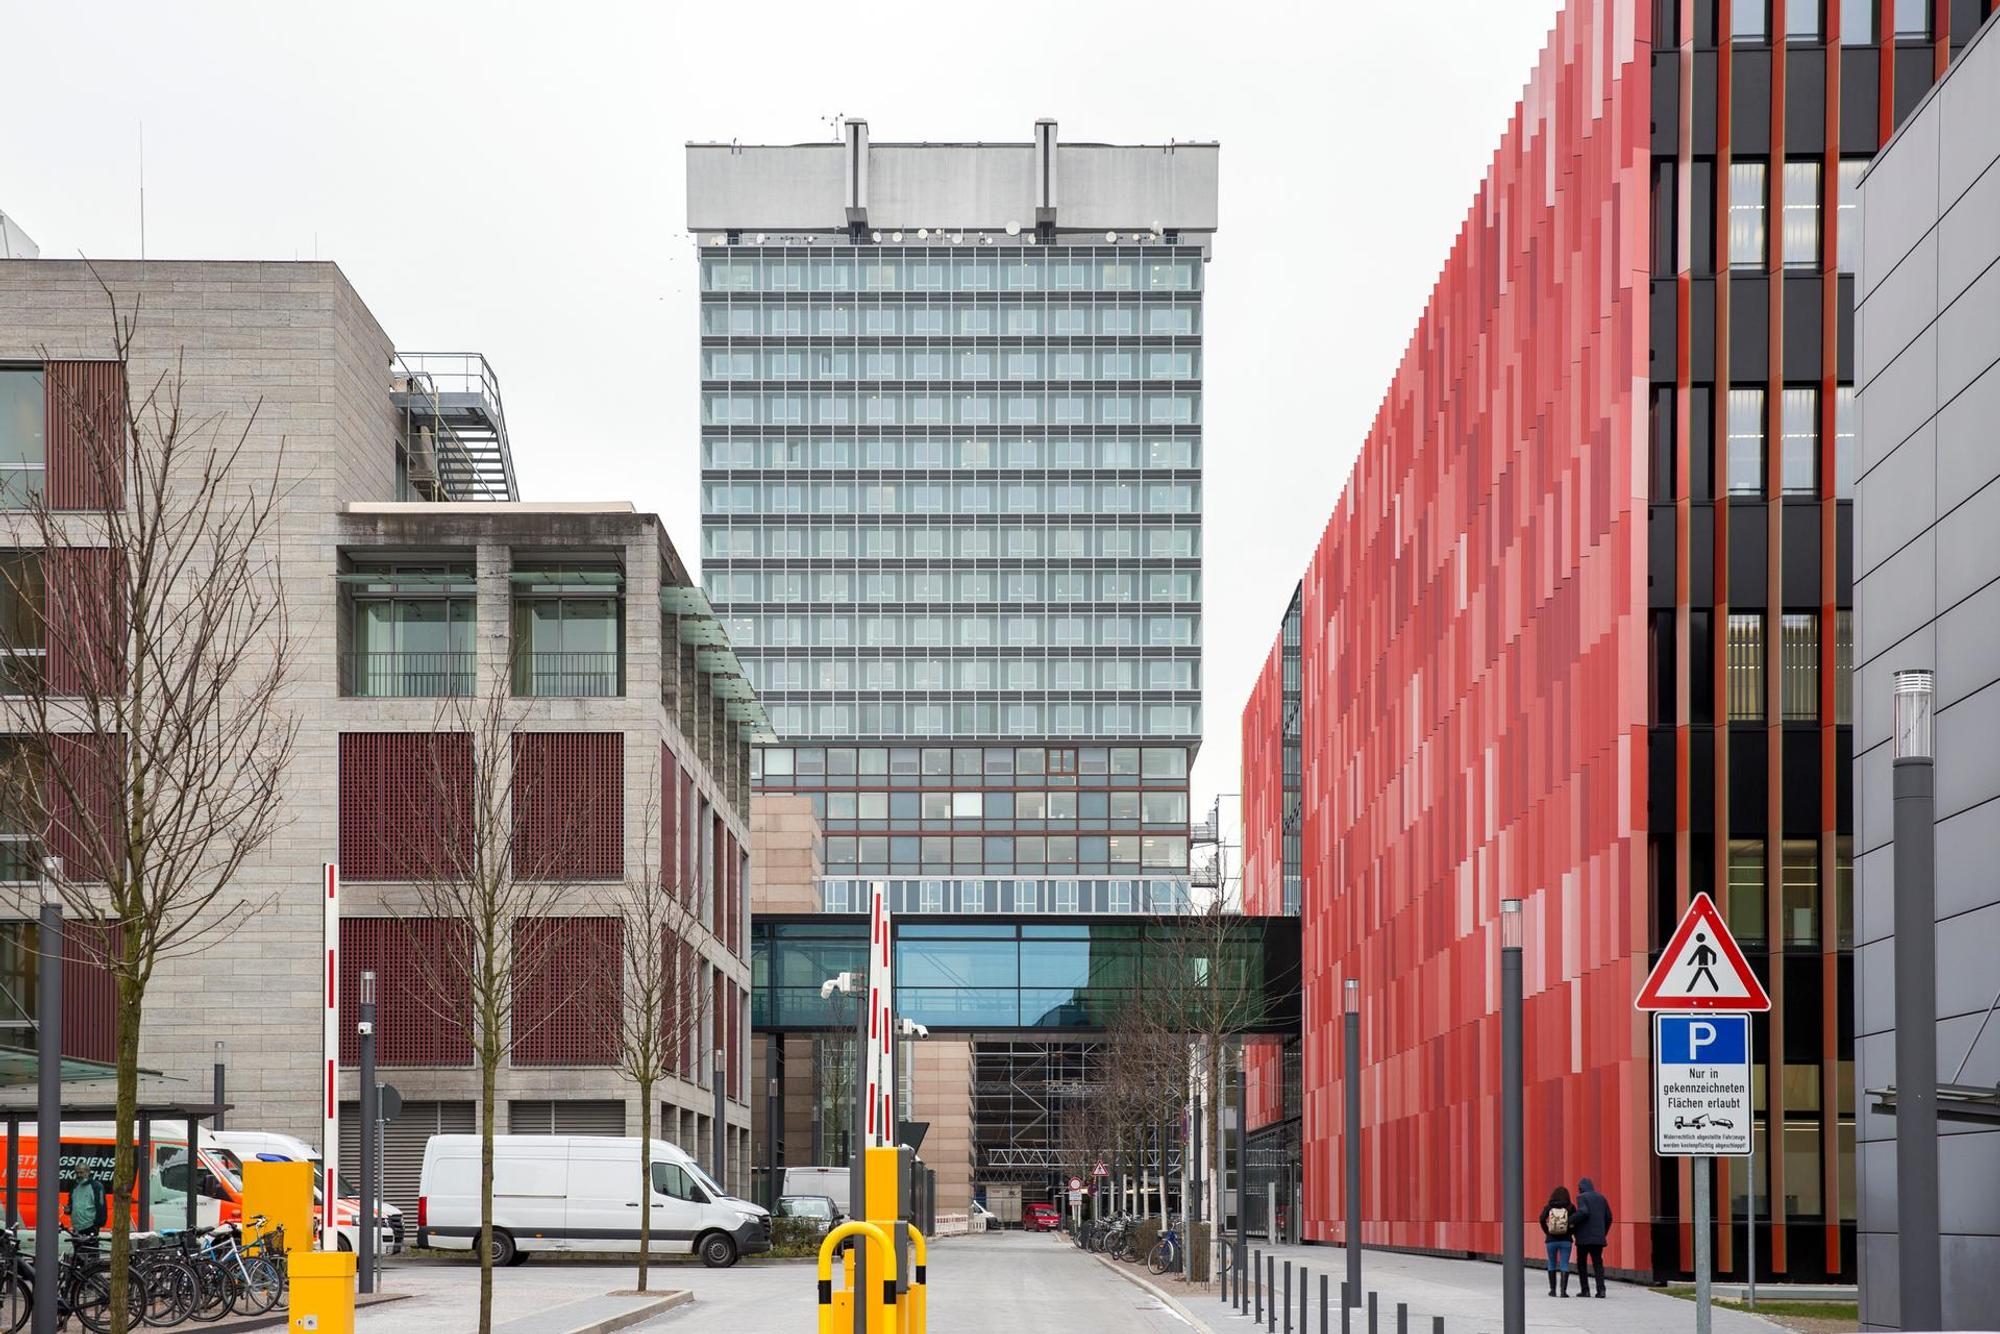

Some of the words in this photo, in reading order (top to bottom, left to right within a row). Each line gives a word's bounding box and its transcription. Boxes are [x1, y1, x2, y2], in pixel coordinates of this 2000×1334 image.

[1689, 1021, 1717, 1060] P
[1689, 1067, 1705, 1079] Nur
[1710, 1067, 1719, 1079] in
[1663, 1082, 1745, 1096] gekennzeichneten
[1668, 1097, 1703, 1108] Flächen
[1707, 1097, 1741, 1108] erlaubt
